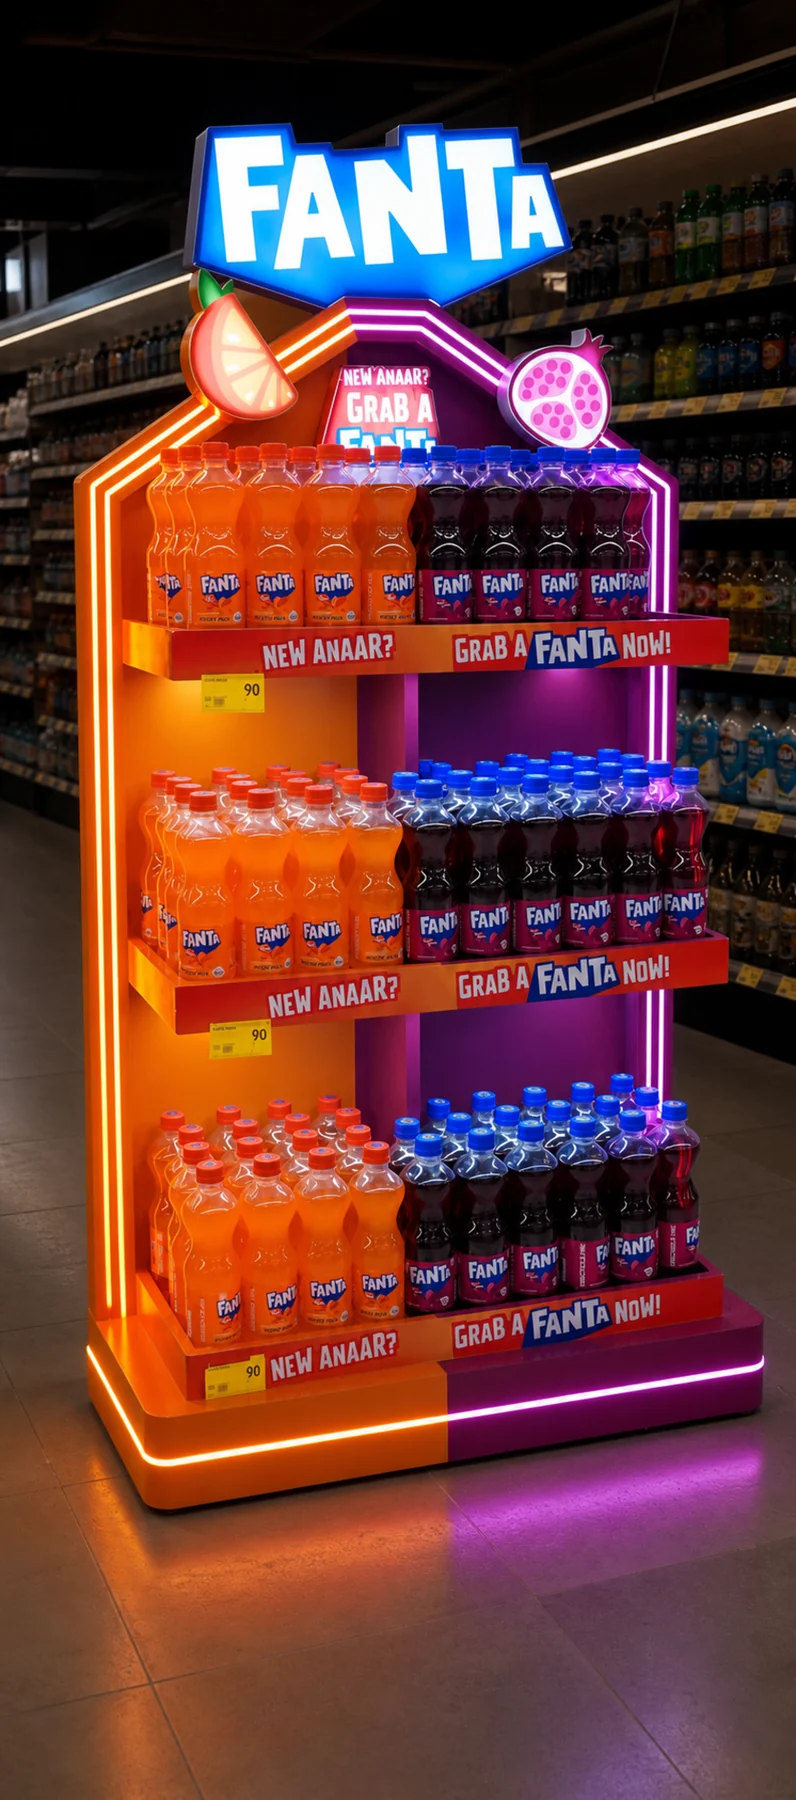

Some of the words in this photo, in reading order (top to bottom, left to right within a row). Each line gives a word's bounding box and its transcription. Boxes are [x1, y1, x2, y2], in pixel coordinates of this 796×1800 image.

[214, 134, 565, 270] FANTA
[343, 367, 372, 387] NEW
[376, 367, 430, 386] ANAAR?
[346, 391, 410, 424] GRAB
[417, 393, 434, 423] A
[201, 573, 240, 593] FANTA
[256, 573, 295, 593] FANTA
[314, 573, 354, 593] FANTA
[383, 573, 415, 593] FANT
[482, 572, 524, 595] FANTA
[263, 639, 306, 670] NEW
[313, 633, 394, 665] ANAAR?
[455, 635, 508, 664] GRAB
[514, 634, 528, 658] A
[535, 628, 617, 665] FANTA
[622, 630, 672, 660] NOW!
[244, 683, 260, 696] 90
[664, 892, 705, 912] FANTA
[303, 920, 341, 940] FANTA
[370, 914, 402, 935] FANT
[182, 930, 220, 948] FANTA
[459, 969, 511, 1000] GRAB
[517, 966, 530, 990] A
[538, 957, 618, 996] FANTA
[623, 955, 670, 985] NOW!
[268, 987, 312, 1018] NEW
[319, 976, 398, 1010] ANAAR?
[252, 1029, 267, 1041] 90
[615, 1235, 655, 1256] FANTA
[362, 1272, 398, 1293] FANTA
[409, 1263, 451, 1285] FANTA
[310, 1277, 347, 1298] FANTA
[454, 1316, 506, 1349] GRAB
[511, 1312, 525, 1336] A
[531, 1299, 610, 1339] FANTA
[615, 1294, 661, 1325] NOW!
[271, 1347, 313, 1381] NEW
[319, 1332, 397, 1369] ANAAR?
[246, 1365, 261, 1378] 90
